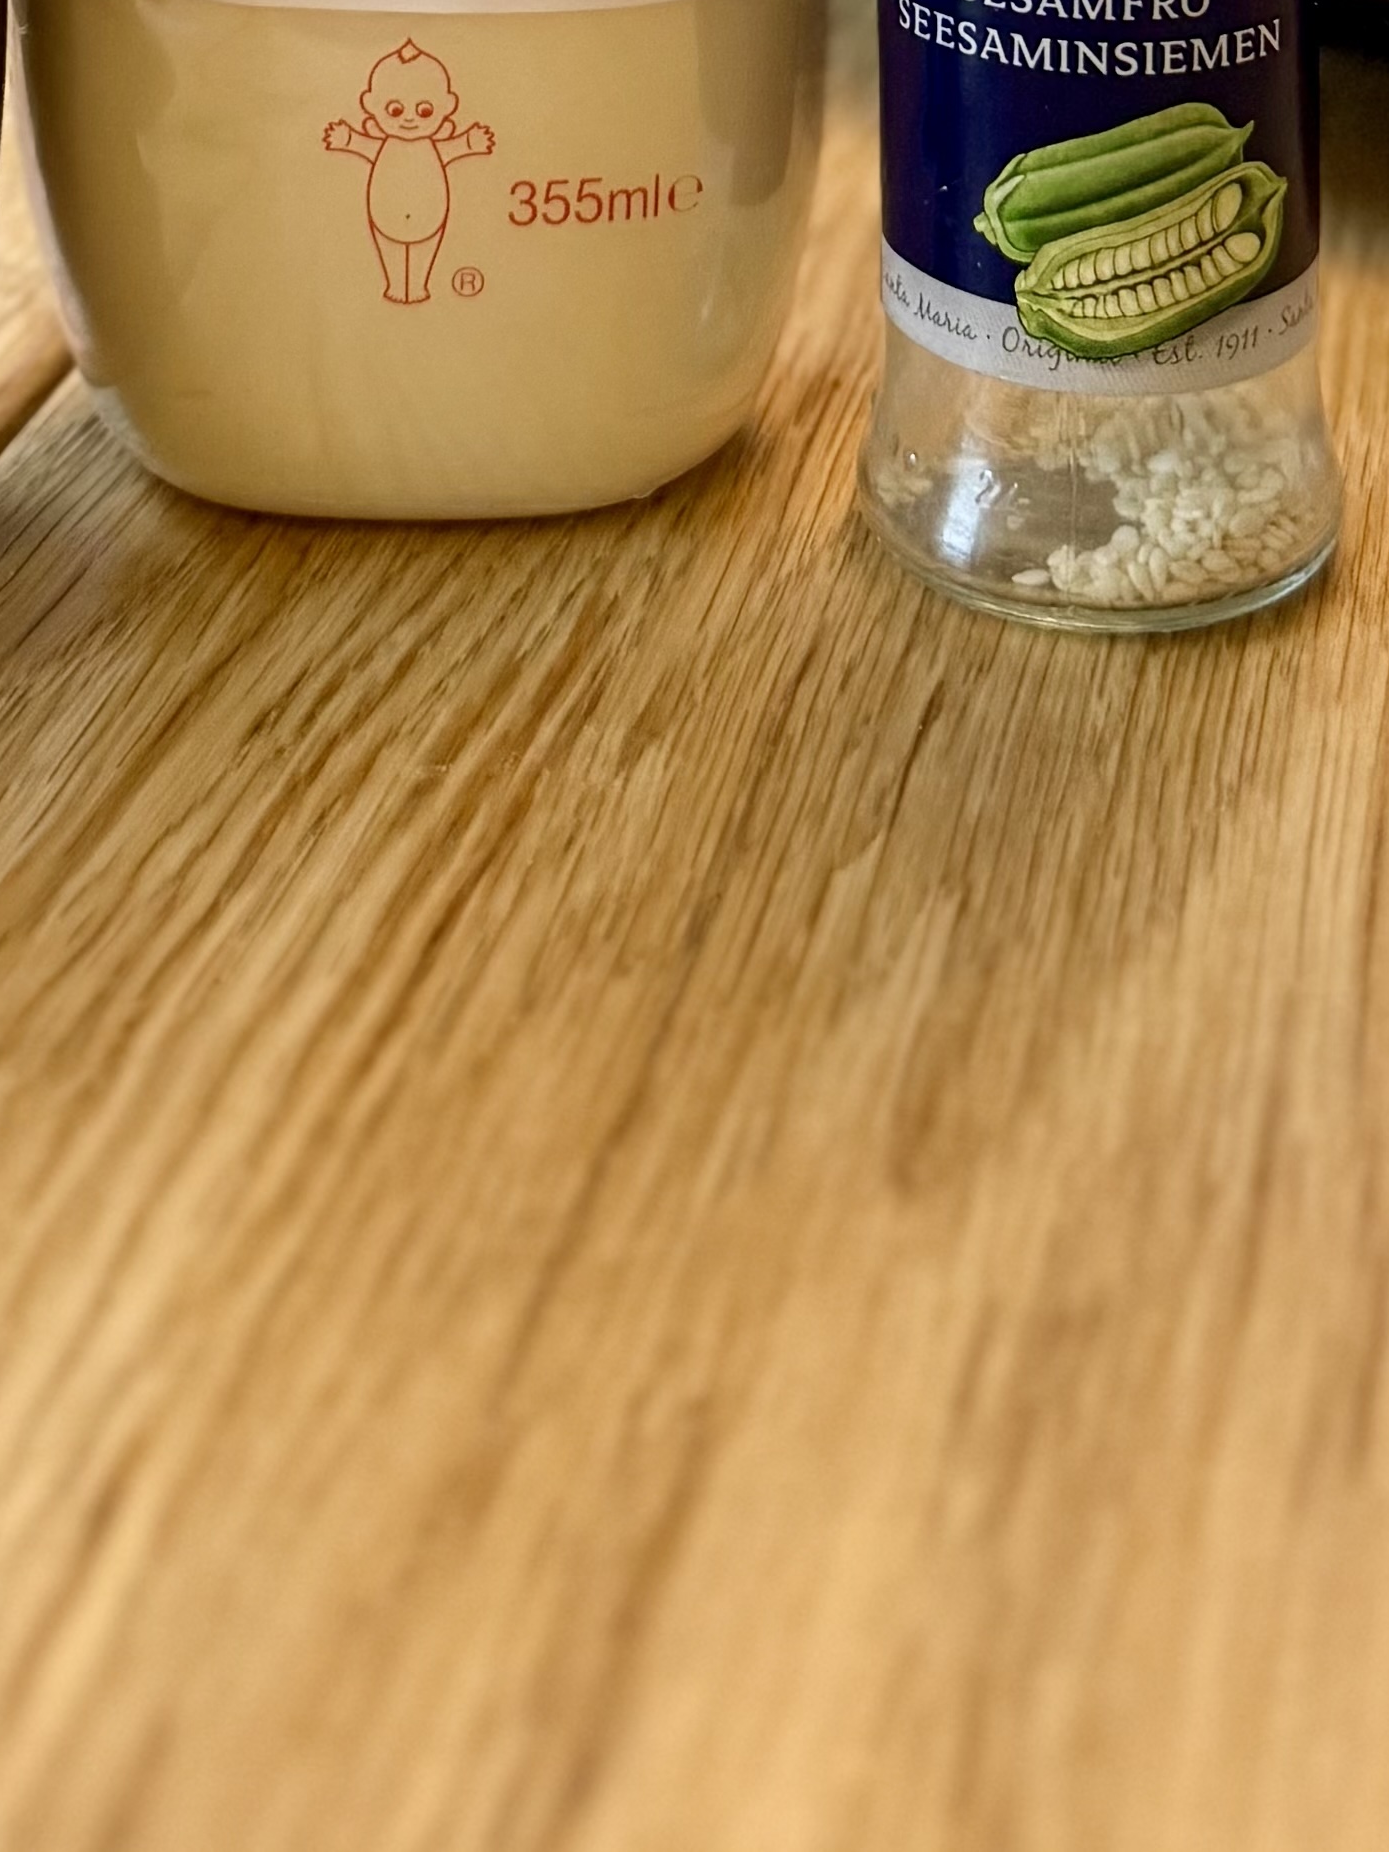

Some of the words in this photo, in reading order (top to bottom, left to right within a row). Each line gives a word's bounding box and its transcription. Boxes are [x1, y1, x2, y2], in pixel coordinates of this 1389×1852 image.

[913, 292, 978, 340] Maria
[1152, 335, 1203, 366] Est.
[1216, 325, 1259, 361] 1911
